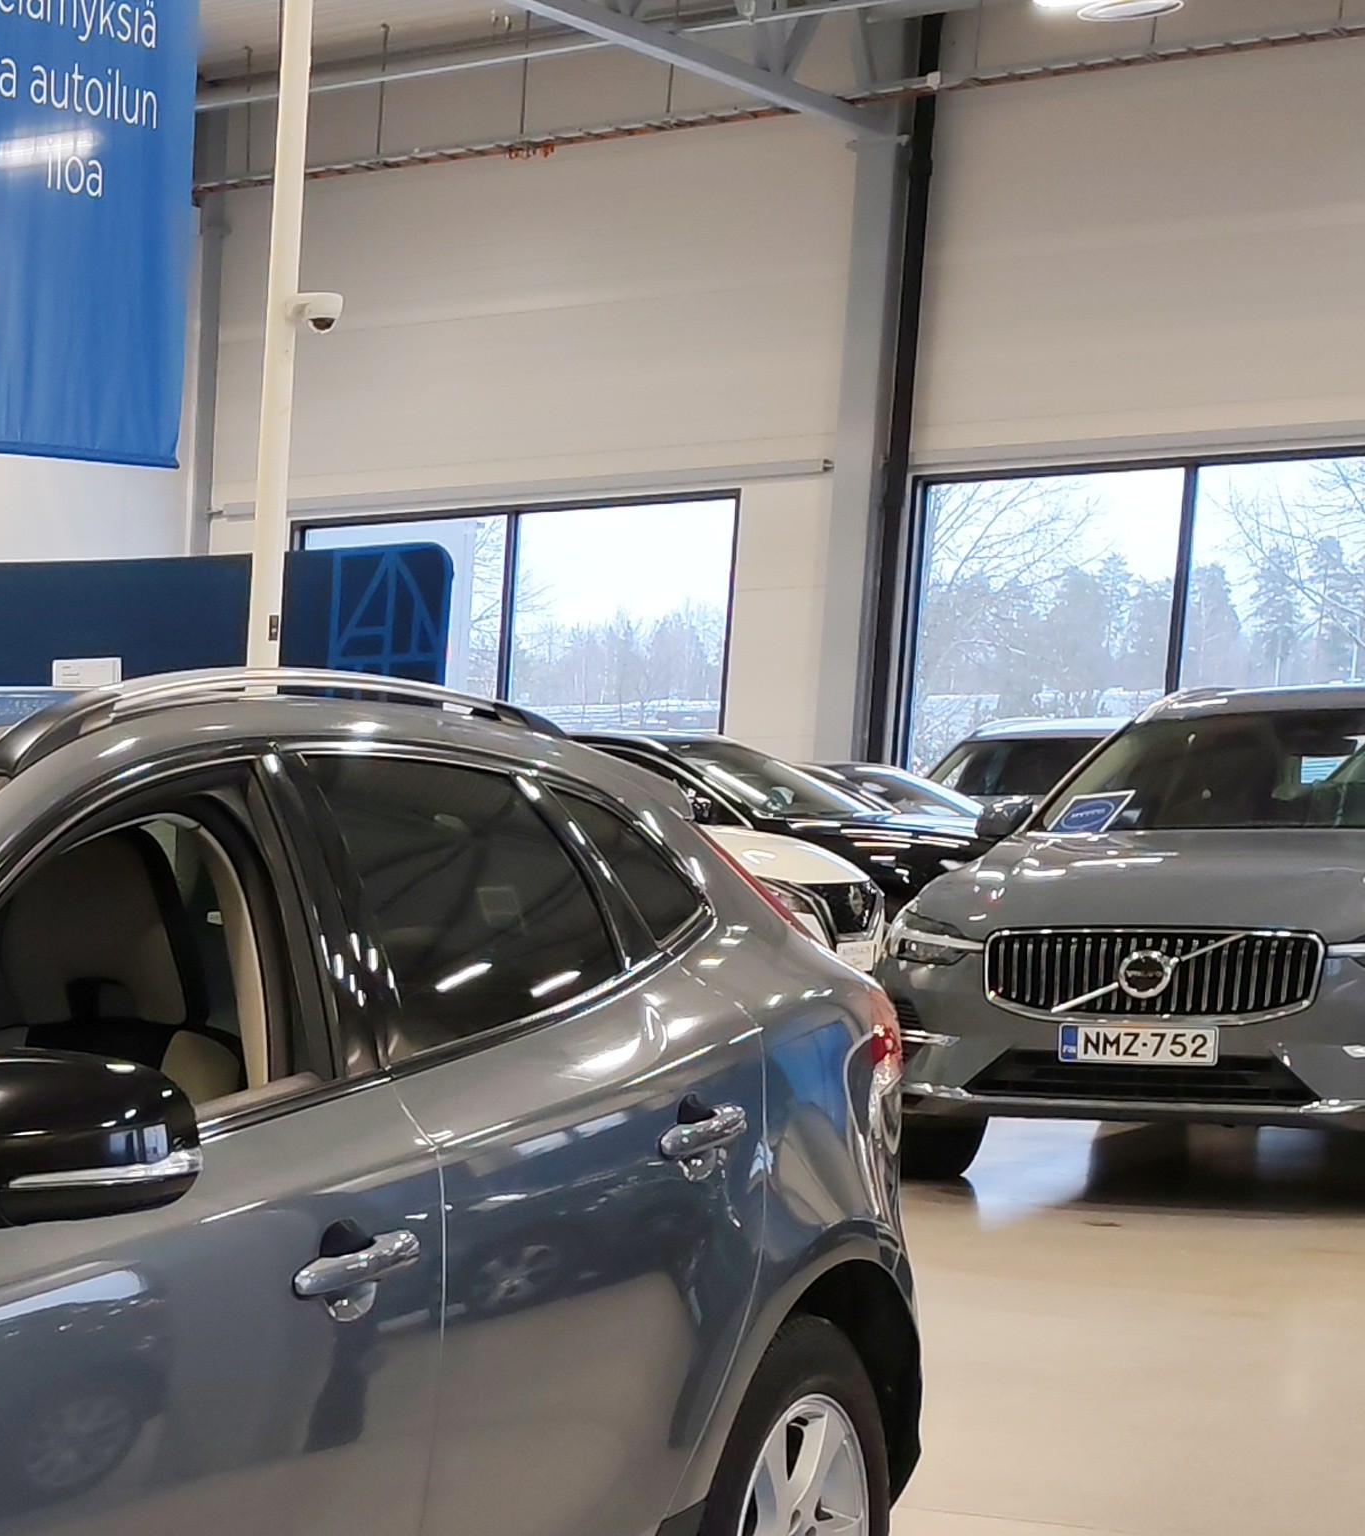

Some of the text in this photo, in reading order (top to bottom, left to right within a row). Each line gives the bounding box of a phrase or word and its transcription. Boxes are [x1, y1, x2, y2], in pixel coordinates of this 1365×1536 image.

[29, 62, 158, 129] autoilun
[46, 137, 103, 197] iloa
[1083, 1031, 1208, 1059] NMZ-752
